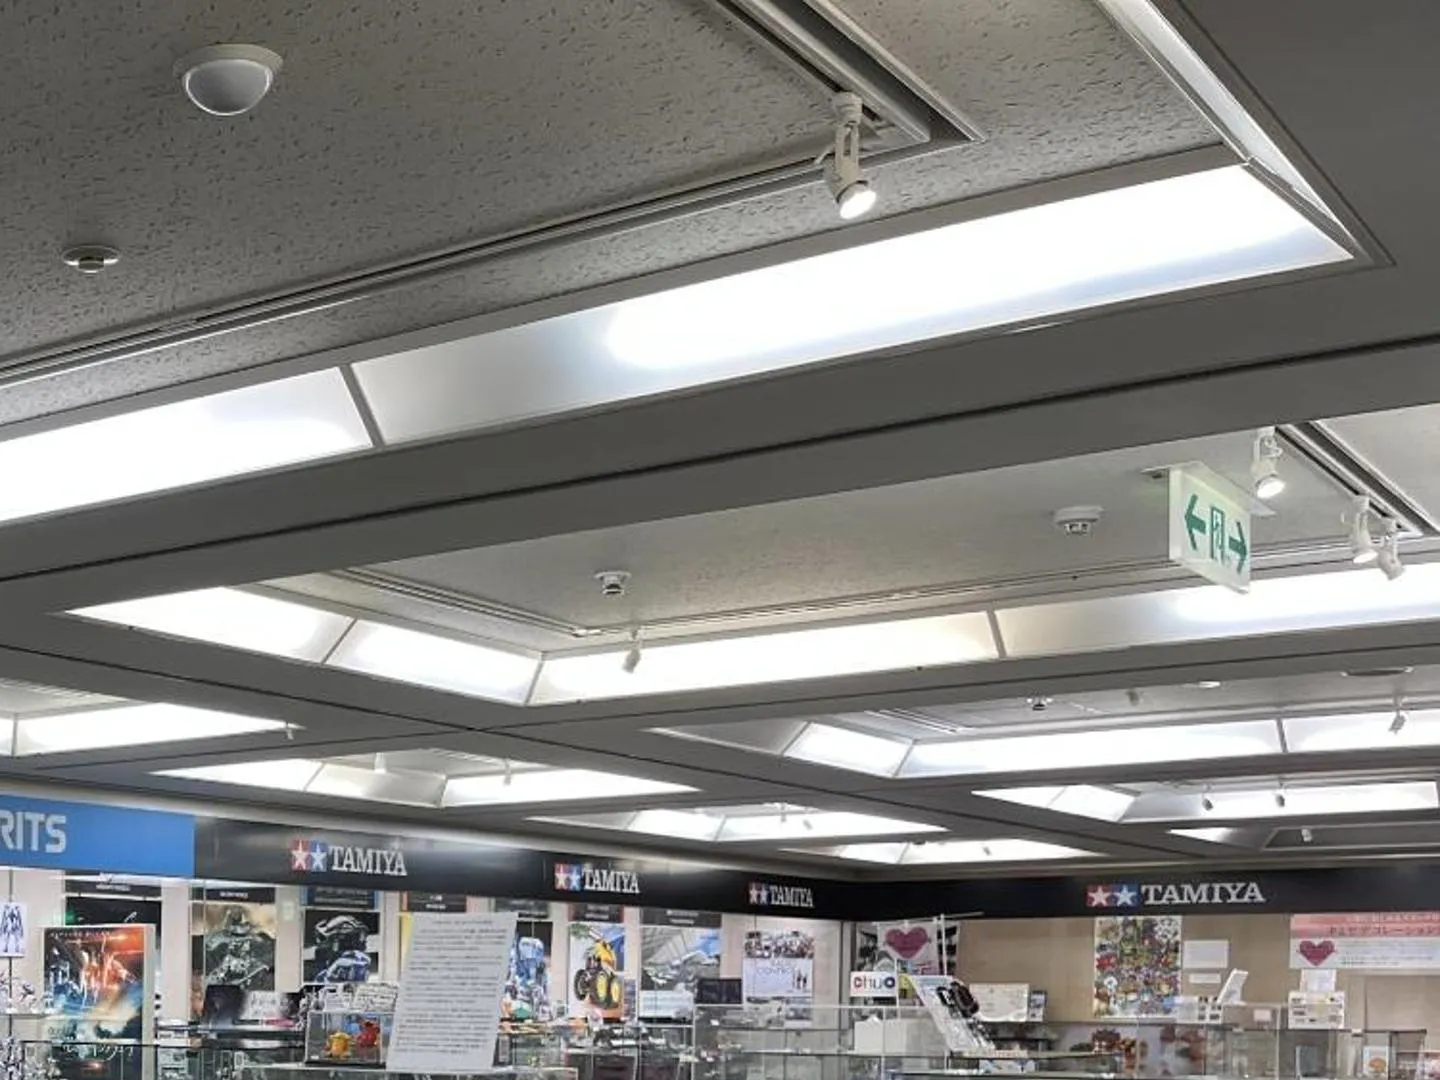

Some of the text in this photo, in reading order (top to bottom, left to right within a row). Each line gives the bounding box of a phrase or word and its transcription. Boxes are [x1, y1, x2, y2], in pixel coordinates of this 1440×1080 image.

[329, 844, 408, 877] TAMIYA
[582, 867, 640, 894] TAMIYA
[769, 885, 814, 908] TAMIYA
[1141, 882, 1266, 905] TAMIYA
